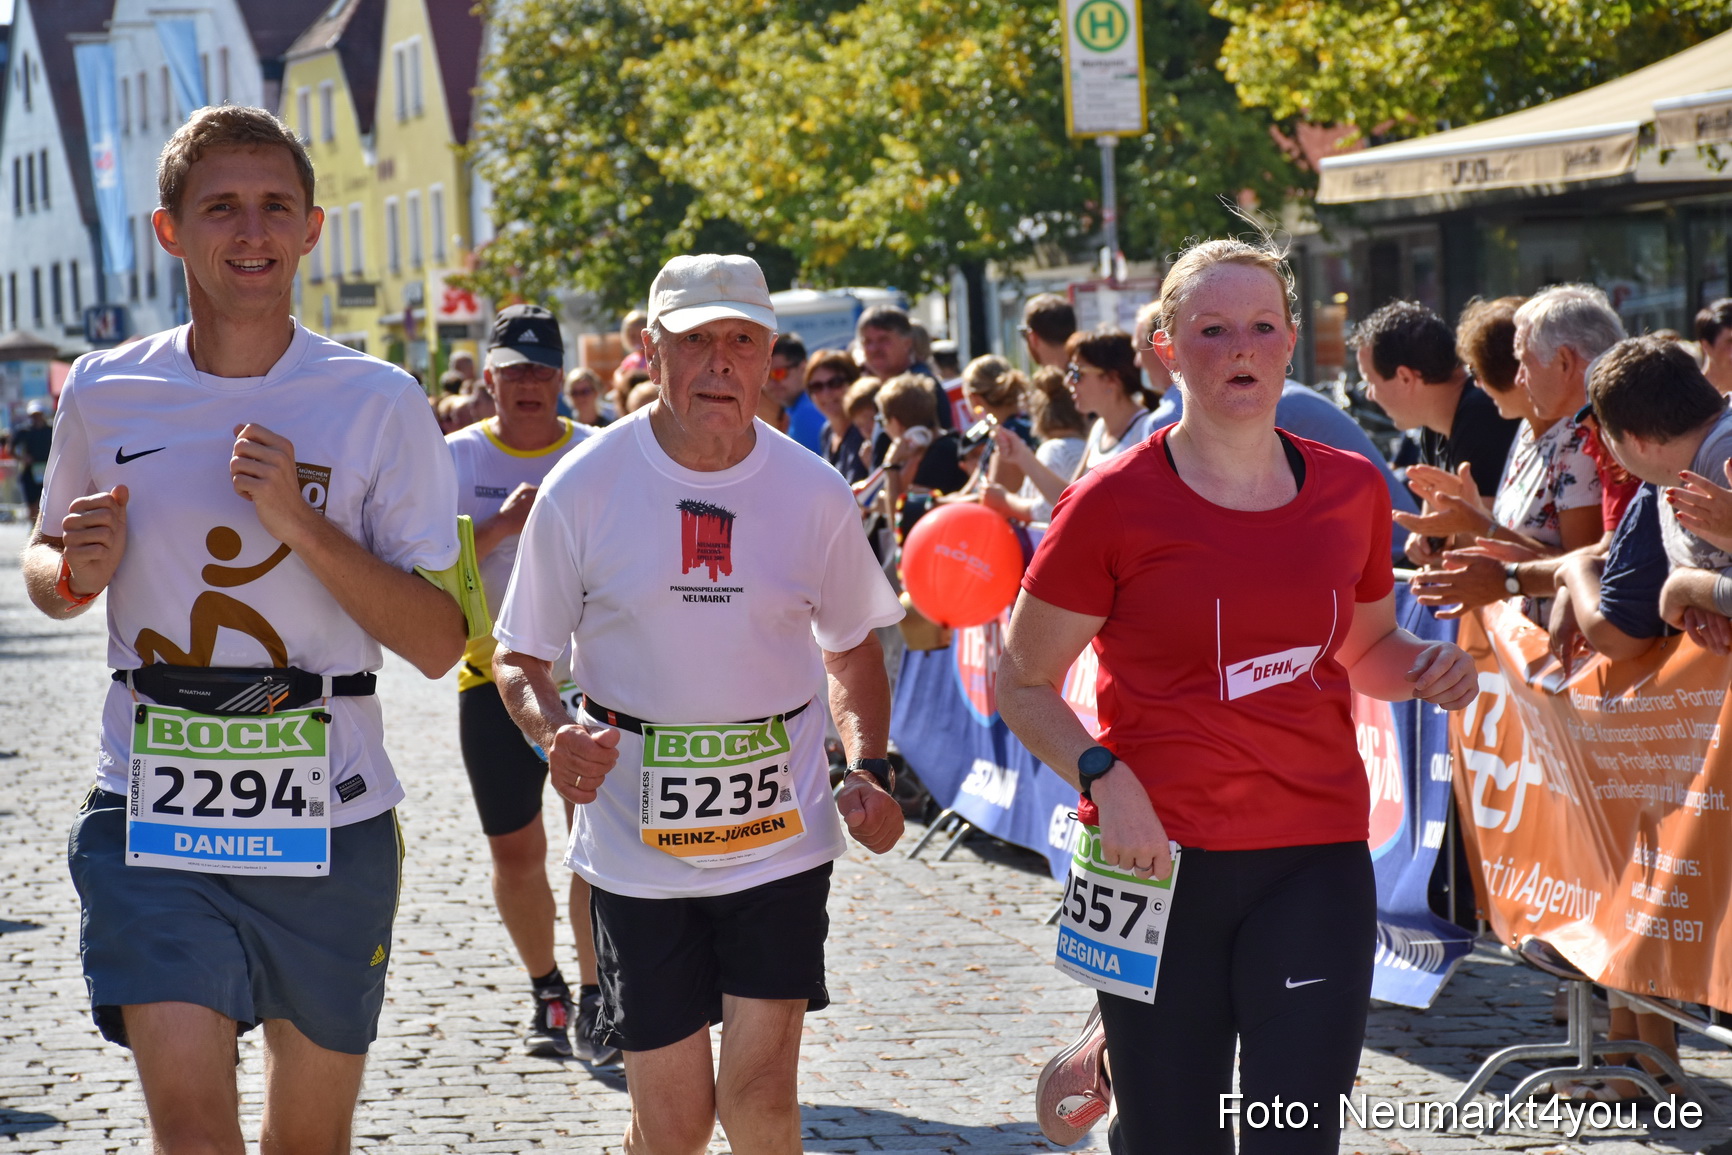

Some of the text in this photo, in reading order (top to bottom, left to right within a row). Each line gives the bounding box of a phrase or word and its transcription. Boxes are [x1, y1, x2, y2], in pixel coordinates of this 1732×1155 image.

[298, 468, 329, 477] MÜNCHEN
[670, 585, 744, 593] PASSIONSSPIELGEMEINDE
[682, 594, 732, 603] NEUMARKT
[1253, 657, 1294, 682] DEHN
[1619, 690, 1677, 714] moderner
[1676, 687, 1724, 707] Partner
[149, 713, 310, 753] BOCK
[655, 723, 780, 761] BOCK
[1582, 721, 1598, 742] die
[1598, 722, 1660, 748] Konzeption
[1661, 718, 1685, 739] und
[1619, 751, 1672, 775] Projekte
[312, 771, 321, 781] D
[152, 766, 307, 818] 2294
[660, 764, 779, 820] 5235
[174, 832, 282, 856] DANIEL
[658, 817, 785, 846] HEINZ-JÜRGEN
[1153, 902, 1162, 911] C
[1673, 919, 1703, 942] 897
[1059, 932, 1121, 975] REGINA
